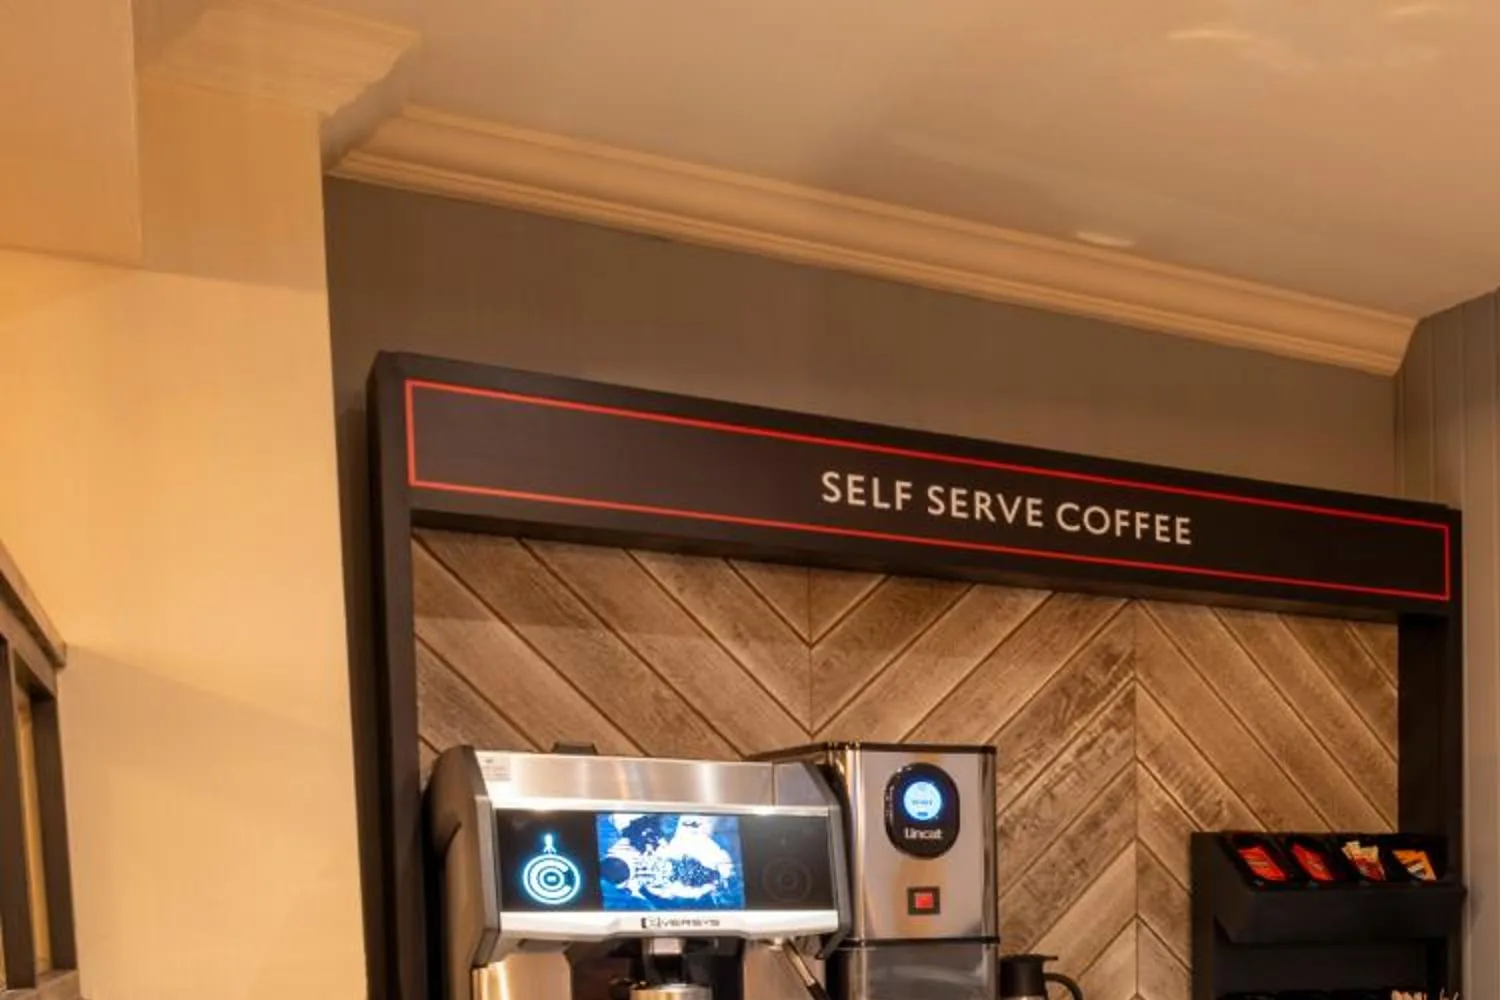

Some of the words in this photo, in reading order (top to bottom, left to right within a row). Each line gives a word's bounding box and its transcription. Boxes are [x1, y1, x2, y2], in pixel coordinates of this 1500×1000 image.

[821, 471, 912, 511] SELF
[927, 485, 1043, 528] SERVE
[1056, 502, 1192, 545] COFFEE
